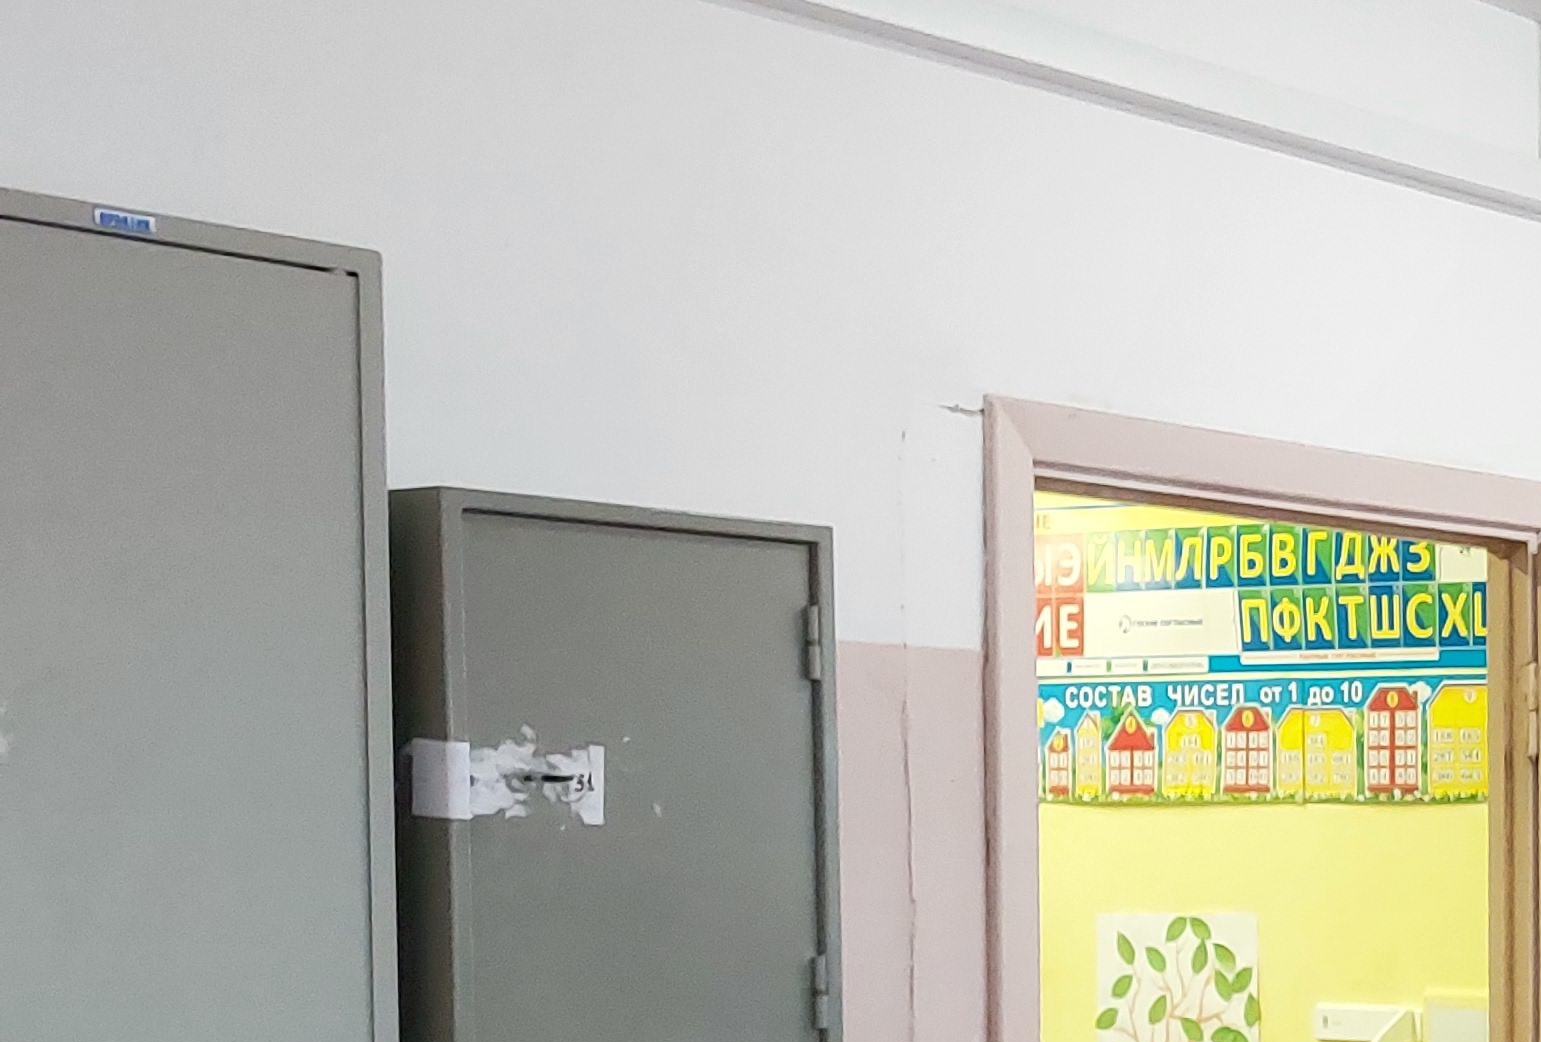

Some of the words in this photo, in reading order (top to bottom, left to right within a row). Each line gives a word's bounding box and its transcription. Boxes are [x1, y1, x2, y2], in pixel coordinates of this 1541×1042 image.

[1065, 685, 1153, 708] СОСТАВ
[1167, 683, 1245, 706] ЧИСЕЛ
[1260, 686, 1282, 703] от
[1288, 680, 1298, 703] 1
[1307, 685, 1334, 706] до
[1340, 680, 1363, 703] 10
